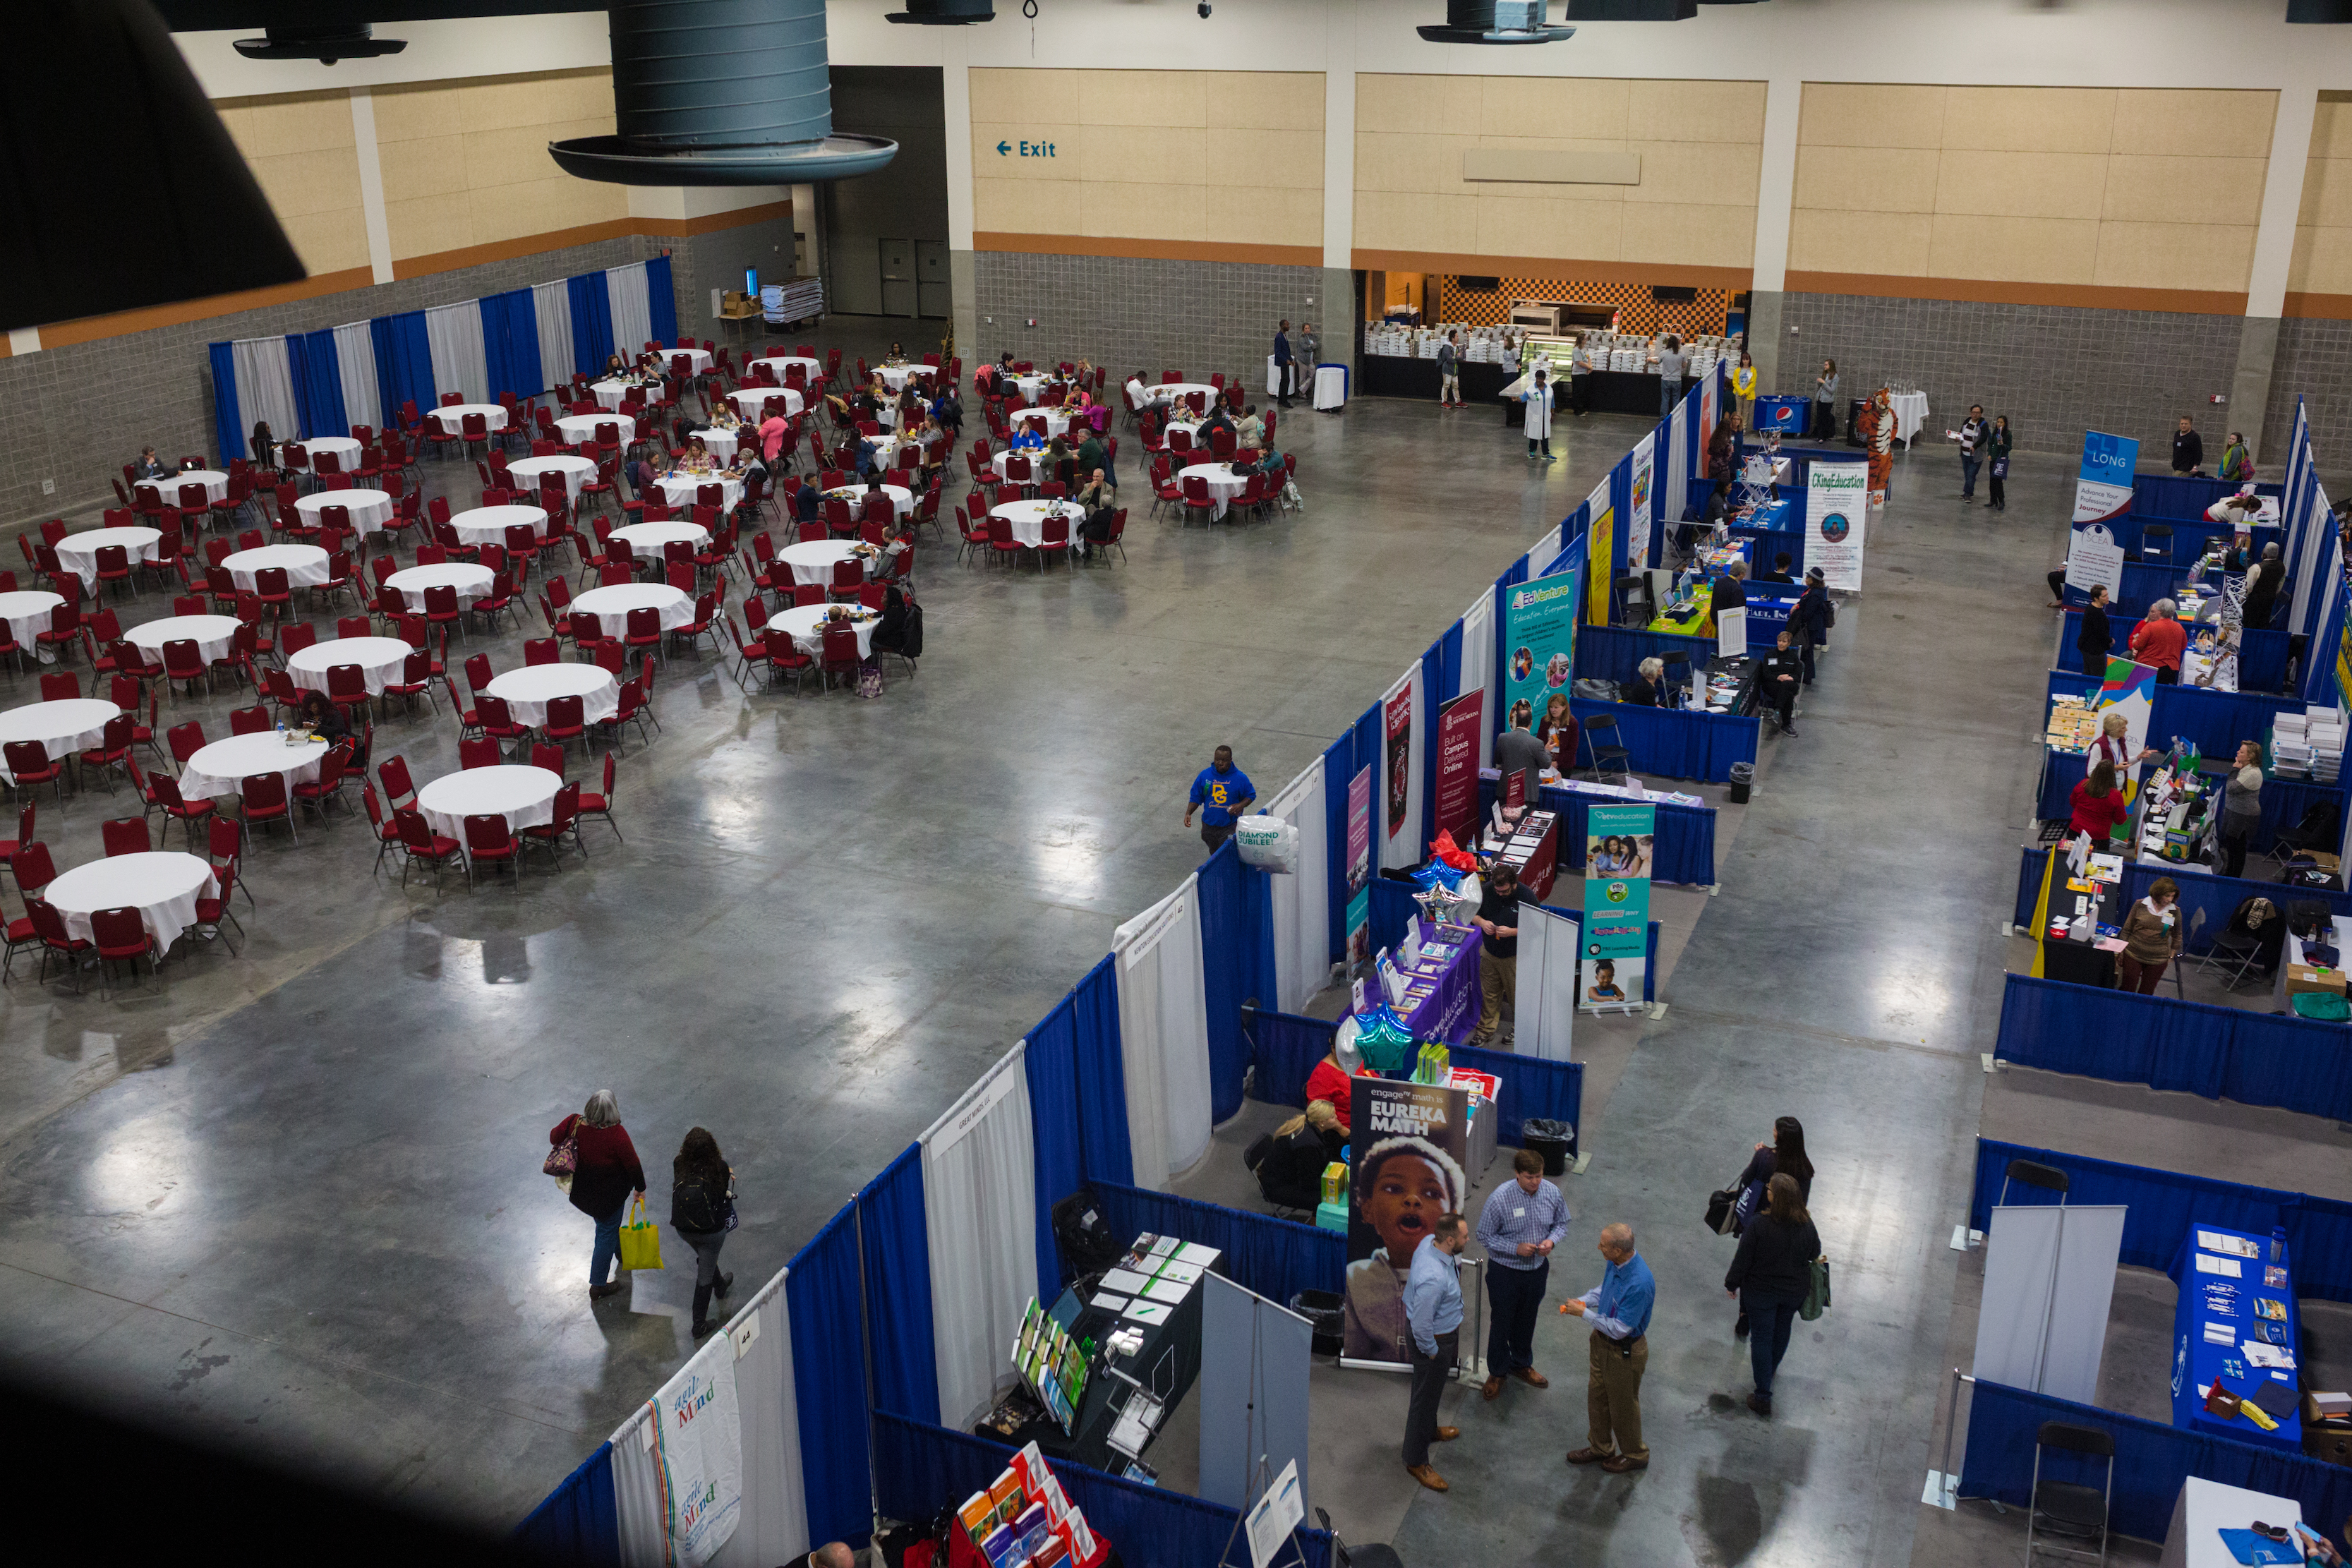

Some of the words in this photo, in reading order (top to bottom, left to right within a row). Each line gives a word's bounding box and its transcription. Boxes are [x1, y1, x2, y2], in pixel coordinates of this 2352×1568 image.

[1020, 140, 1056, 157] Exit
[2092, 452, 2126, 468] LONG
[1812, 473, 1864, 492] CKingEducation
[2081, 488, 2104, 497] Advance
[2080, 495, 2112, 507] Professional
[2079, 504, 2106, 515] Journey
[2086, 533, 2109, 545] SCEA
[1523, 585, 1568, 605] EdVenture
[1537, 632, 1555, 641] Southeast
[1445, 735, 1455, 747] Built
[1457, 732, 1464, 742] on
[1444, 740, 1469, 756] Campus
[1444, 748, 1469, 766] Delivered
[1444, 761, 1463, 775] Online
[1238, 837, 1273, 845] JUBILEE!
[1178, 905, 1183, 913] 42
[1134, 939, 1147, 956] NEWTON
[1147, 925, 1162, 944] EDUCATION
[1161, 911, 1174, 929] SOLUTIONS
[1412, 1093, 1435, 1102] math
[1370, 1099, 1447, 1123] EUREKA
[959, 1113, 972, 1130] GREAT
[1370, 1116, 1429, 1136] MATH
[742, 1329, 750, 1344] 44
[679, 1379, 714, 1429] Mind
[682, 1479, 701, 1516] agile
[685, 1482, 716, 1534] Mind
